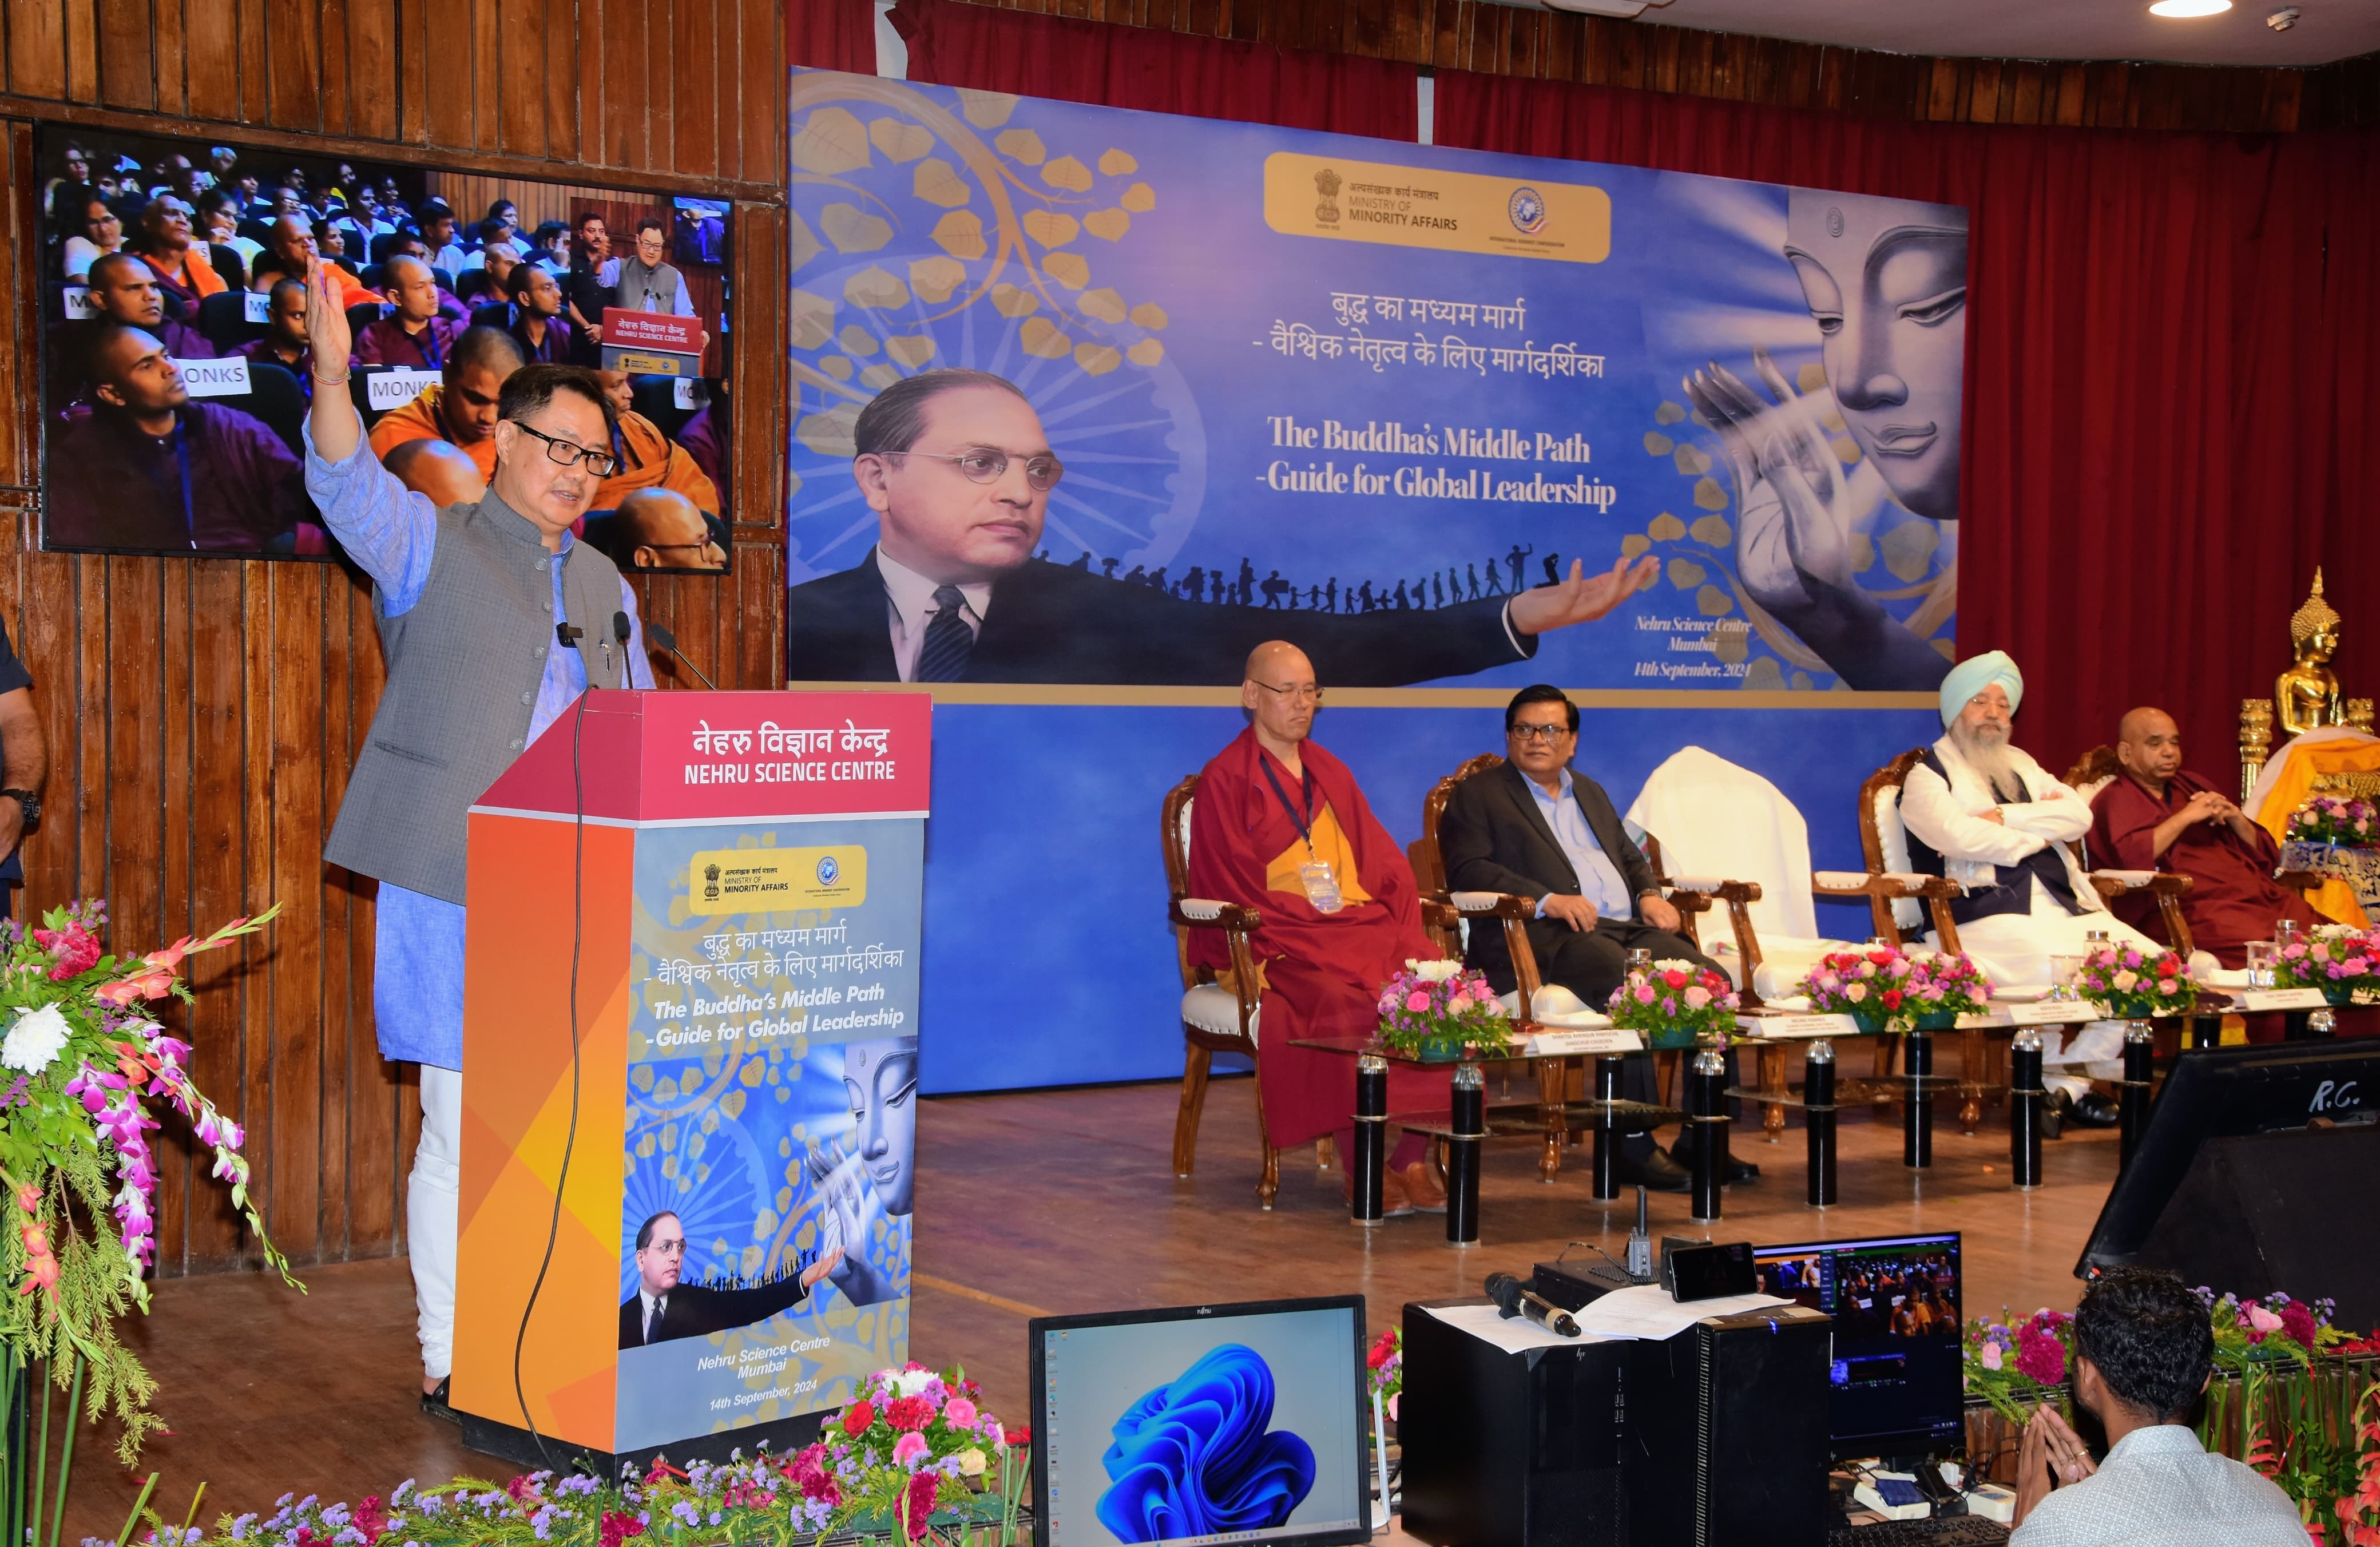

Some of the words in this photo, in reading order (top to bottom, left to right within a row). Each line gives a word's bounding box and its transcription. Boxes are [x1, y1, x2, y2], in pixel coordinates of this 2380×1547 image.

[1349, 196, 1396, 209] MINISTRY
[1398, 201, 1411, 211] OF
[1349, 209, 1408, 225] MINORITY
[1411, 215, 1457, 230] AFFAIRS
[1331, 292, 1369, 326] बुद्ध
[1373, 296, 1404, 320] का
[1409, 299, 1477, 327] मध्यम
[1482, 298, 1526, 330] मार्ग
[615, 330, 638, 338] NEHRU
[638, 332, 664, 340] SCIENCE
[664, 335, 688, 343] CENTRE
[1348, 328, 1409, 372] नेतृत्व
[1413, 332, 1437, 366] के
[1441, 335, 1486, 376] लिए
[1490, 341, 1605, 379] मार्गदर्शिका
[185, 367, 244, 383] ONKS
[373, 381, 437, 396] MONK
[1267, 416, 1318, 448] The
[1442, 427, 1531, 460] Middle
[1534, 433, 1590, 463] Path
[1352, 463, 1391, 495] for
[1394, 467, 1477, 499] Global
[1482, 471, 1616, 514] Leadership
[1635, 615, 1671, 631] Nehru
[1672, 617, 1715, 632] Science
[1715, 617, 1752, 633] Centre
[1667, 636, 1717, 652] Mumbai
[1634, 661, 1658, 676] 14th
[1659, 662, 1721, 681] September,
[1723, 663, 1751, 677] 2024
[758, 721, 834, 759] विज्ञान
[839, 718, 890, 757] केन्द्र
[685, 763, 749, 784] NEHRU
[755, 761, 826, 783] SCIENCE
[831, 760, 895, 780] CENTRE
[724, 884, 759, 893] MINORITY
[761, 883, 788, 891] AFFAIRS
[703, 933, 731, 960] बुद्ध
[735, 931, 756, 950] का
[761, 928, 811, 949] मध्यम
[815, 918, 847, 944] मार्ग
[715, 955, 760, 987] नेतृत्व
[763, 952, 779, 975] के
[784, 951, 817, 978] लिए
[820, 942, 904, 974] मार्गदर्शिका
[654, 1000, 687, 1020] The
[781, 987, 842, 1009] Middle
[846, 983, 884, 1003] Path
[717, 1022, 743, 1040] for
[749, 1016, 807, 1037] Global
[812, 1007, 905, 1032] Leadership
[1197, 1306, 1212, 1315] FUJITSU
[697, 1354, 735, 1371] Nehru
[739, 1344, 787, 1363] Science
[791, 1336, 830, 1353] Centre
[737, 1358, 787, 1379] Mumbai
[710, 1397, 731, 1411] 14th
[733, 1386, 790, 1406] September,
[794, 1379, 817, 1394] 2024
